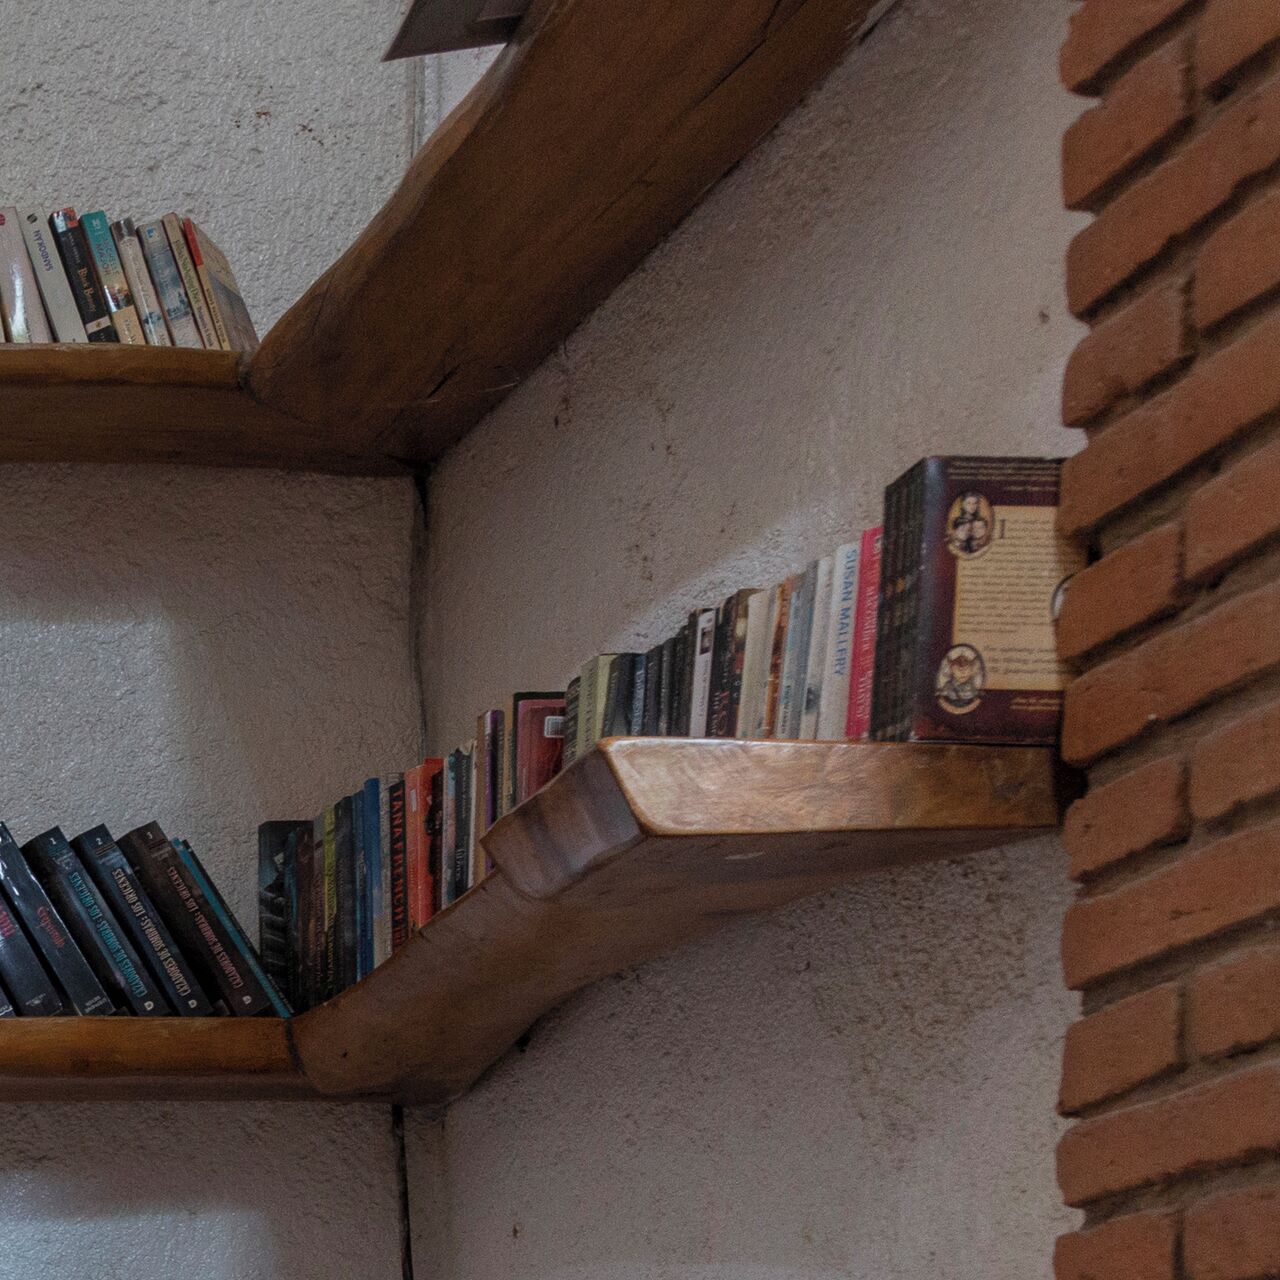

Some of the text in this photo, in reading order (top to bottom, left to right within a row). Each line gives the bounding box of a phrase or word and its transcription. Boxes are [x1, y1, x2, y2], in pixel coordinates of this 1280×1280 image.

[841, 549, 857, 602] SUSAN
[87, 903, 147, 998] CAZADORES DE LOS
[129, 900, 190, 997] CAZADORES DE LOS
[182, 896, 243, 990] CAZADORES DE LOS
